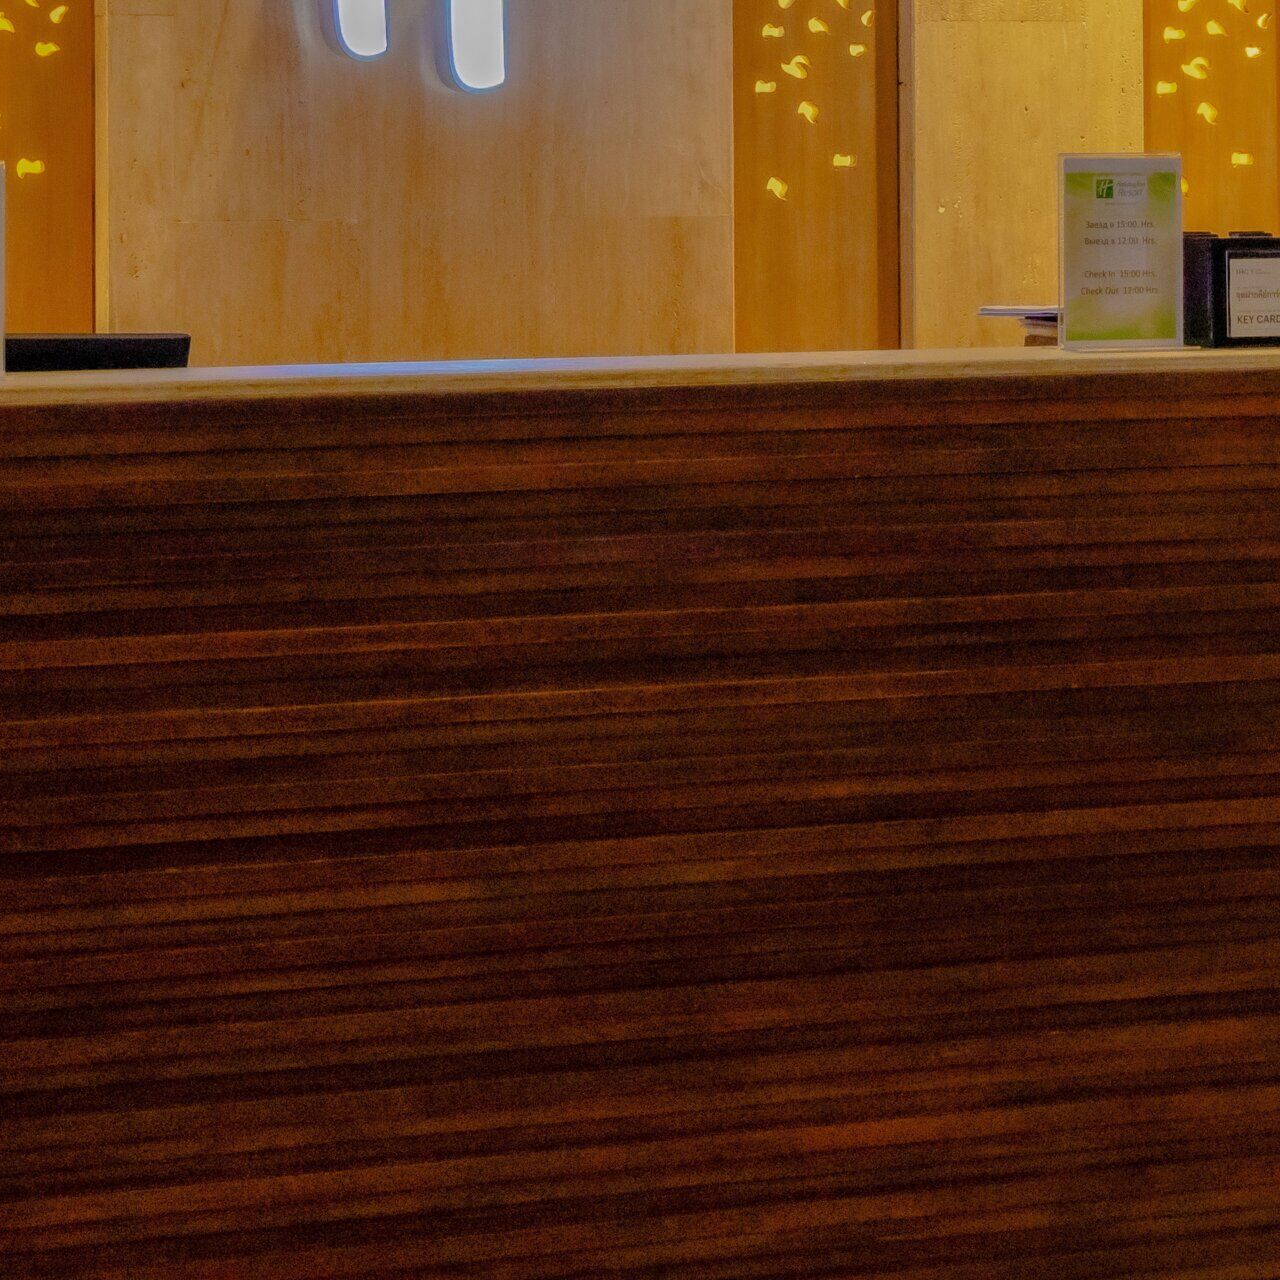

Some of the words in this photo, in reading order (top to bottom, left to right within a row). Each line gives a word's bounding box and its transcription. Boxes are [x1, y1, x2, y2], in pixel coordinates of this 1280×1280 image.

[1084, 270, 1107, 279] Check
[1080, 285, 1104, 296] Check
[1237, 315, 1255, 324] KEY
